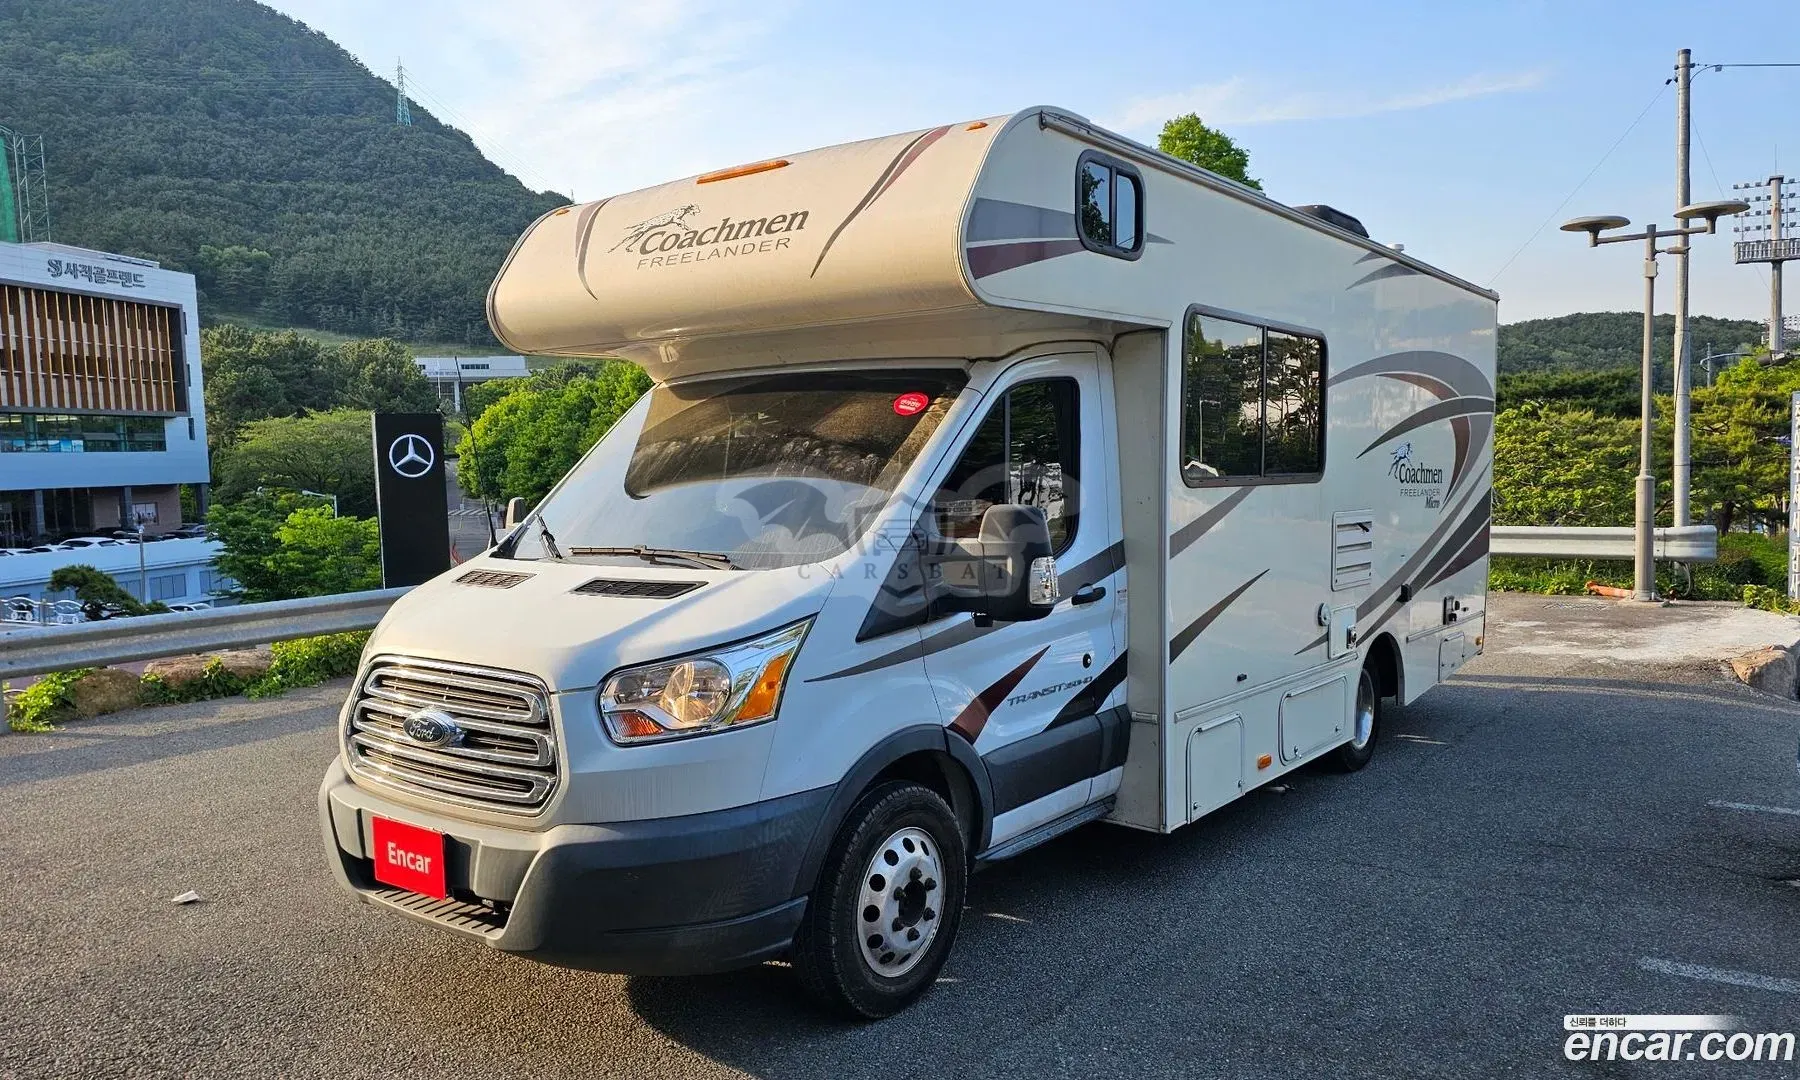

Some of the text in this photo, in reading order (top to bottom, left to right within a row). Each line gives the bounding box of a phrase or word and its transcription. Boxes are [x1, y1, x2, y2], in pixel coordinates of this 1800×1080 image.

[641, 210, 809, 255] Coachmen
[637, 237, 790, 270] FREELANDER
[1399, 462, 1443, 484] Coachmen
[1400, 488, 1440, 497] FREELANDER
[1007, 685, 1062, 706] TRANSIT
[409, 718, 434, 740] Ford
[387, 841, 432, 874] Encar
